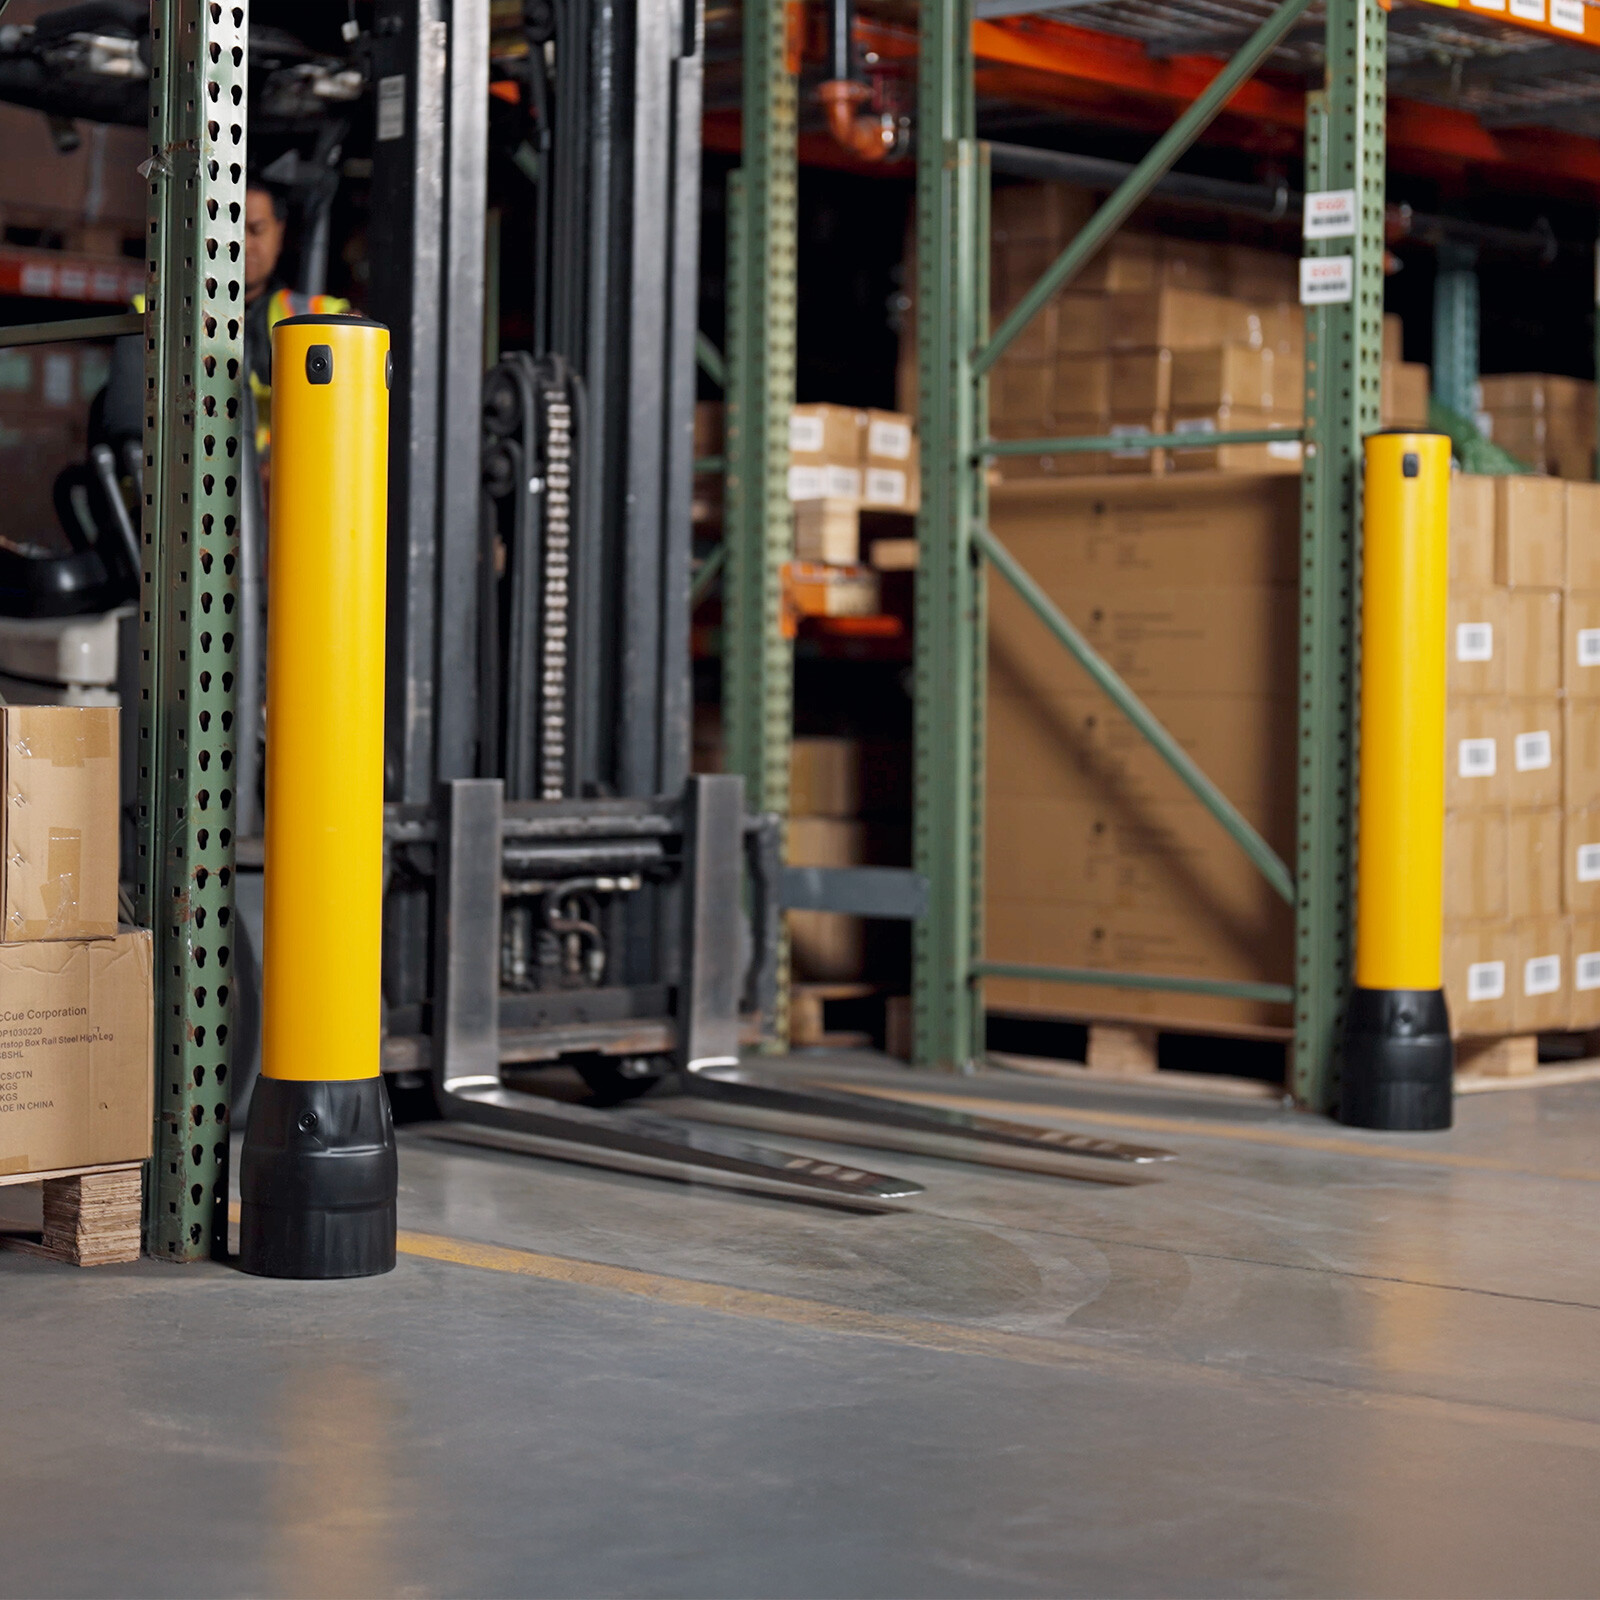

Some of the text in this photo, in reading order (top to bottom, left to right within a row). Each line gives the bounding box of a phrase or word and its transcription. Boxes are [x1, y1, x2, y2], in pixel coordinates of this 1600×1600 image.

[27, 1007, 87, 1020] Corporation
[42, 1037, 57, 1045] Rail
[59, 1035, 78, 1044] Steel
[80, 1034, 97, 1043] High
[99, 1033, 113, 1041] Leg
[0, 1051, 23, 1059] BSHL
[1, 1071, 33, 1080] CS/CTN
[27, 1101, 54, 1110] CHINA
